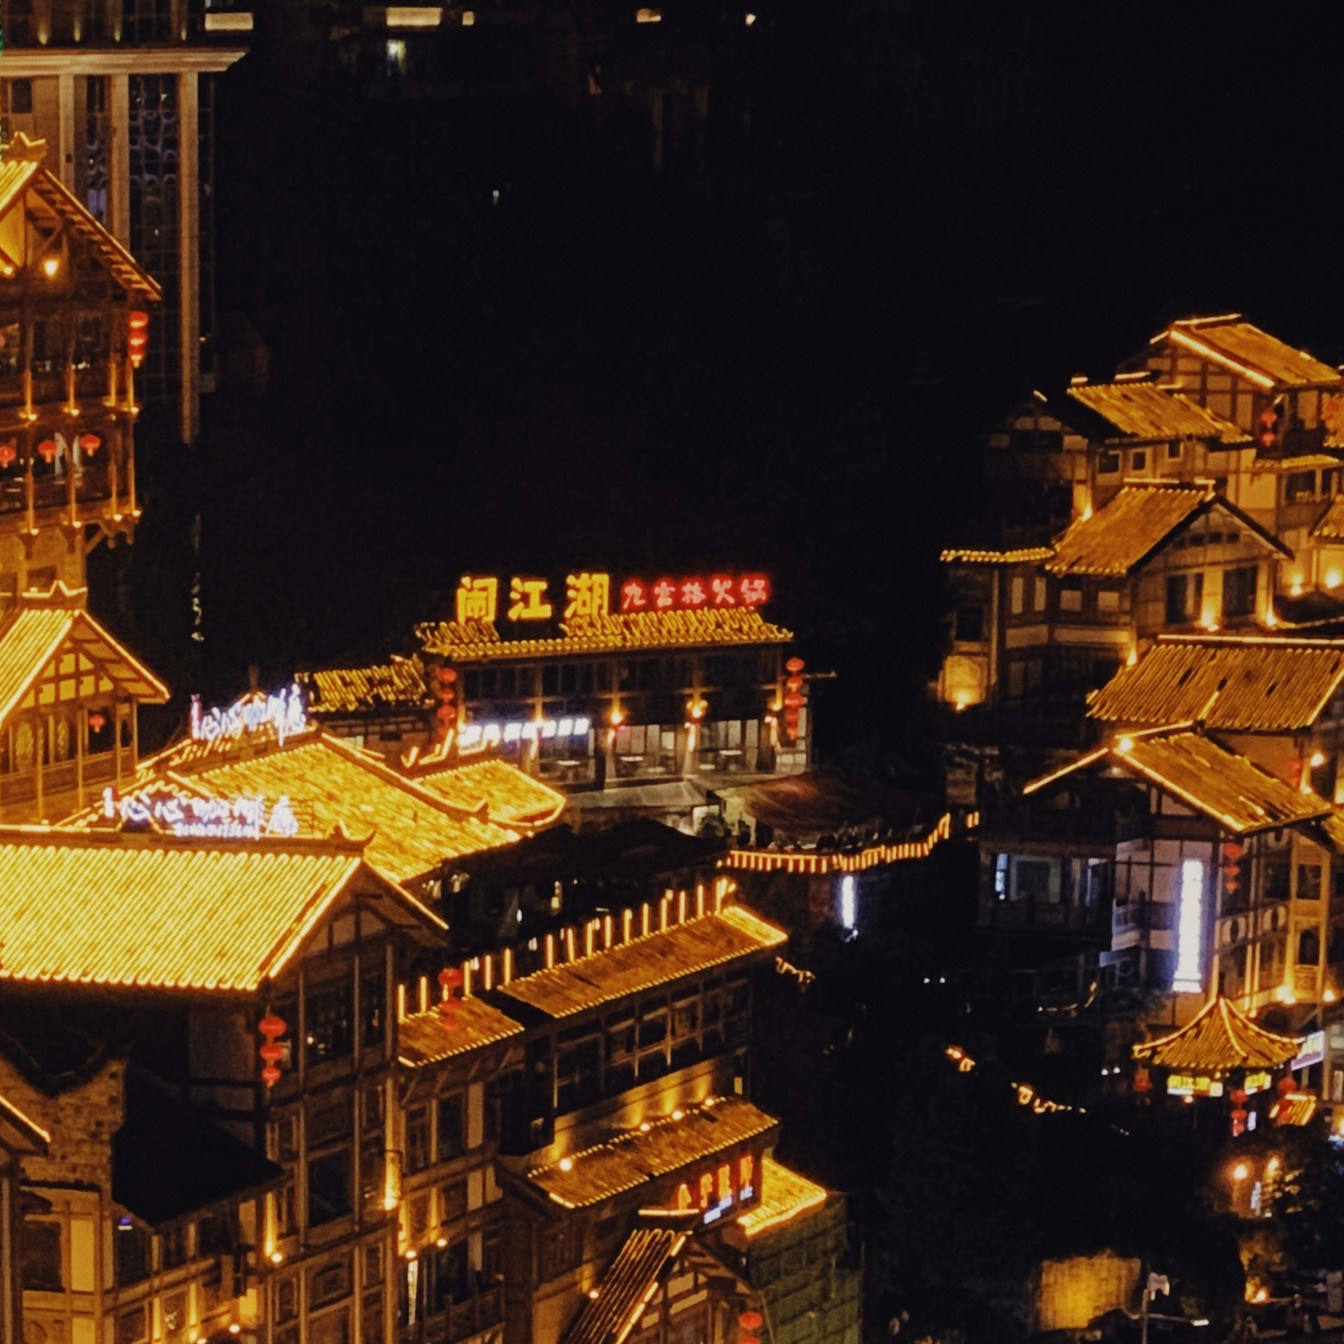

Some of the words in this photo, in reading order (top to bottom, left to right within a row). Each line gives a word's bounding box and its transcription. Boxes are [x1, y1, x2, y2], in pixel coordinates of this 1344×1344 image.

[457, 573, 610, 621] 闹江湖
[623, 577, 768, 608] 九宫格火锅
